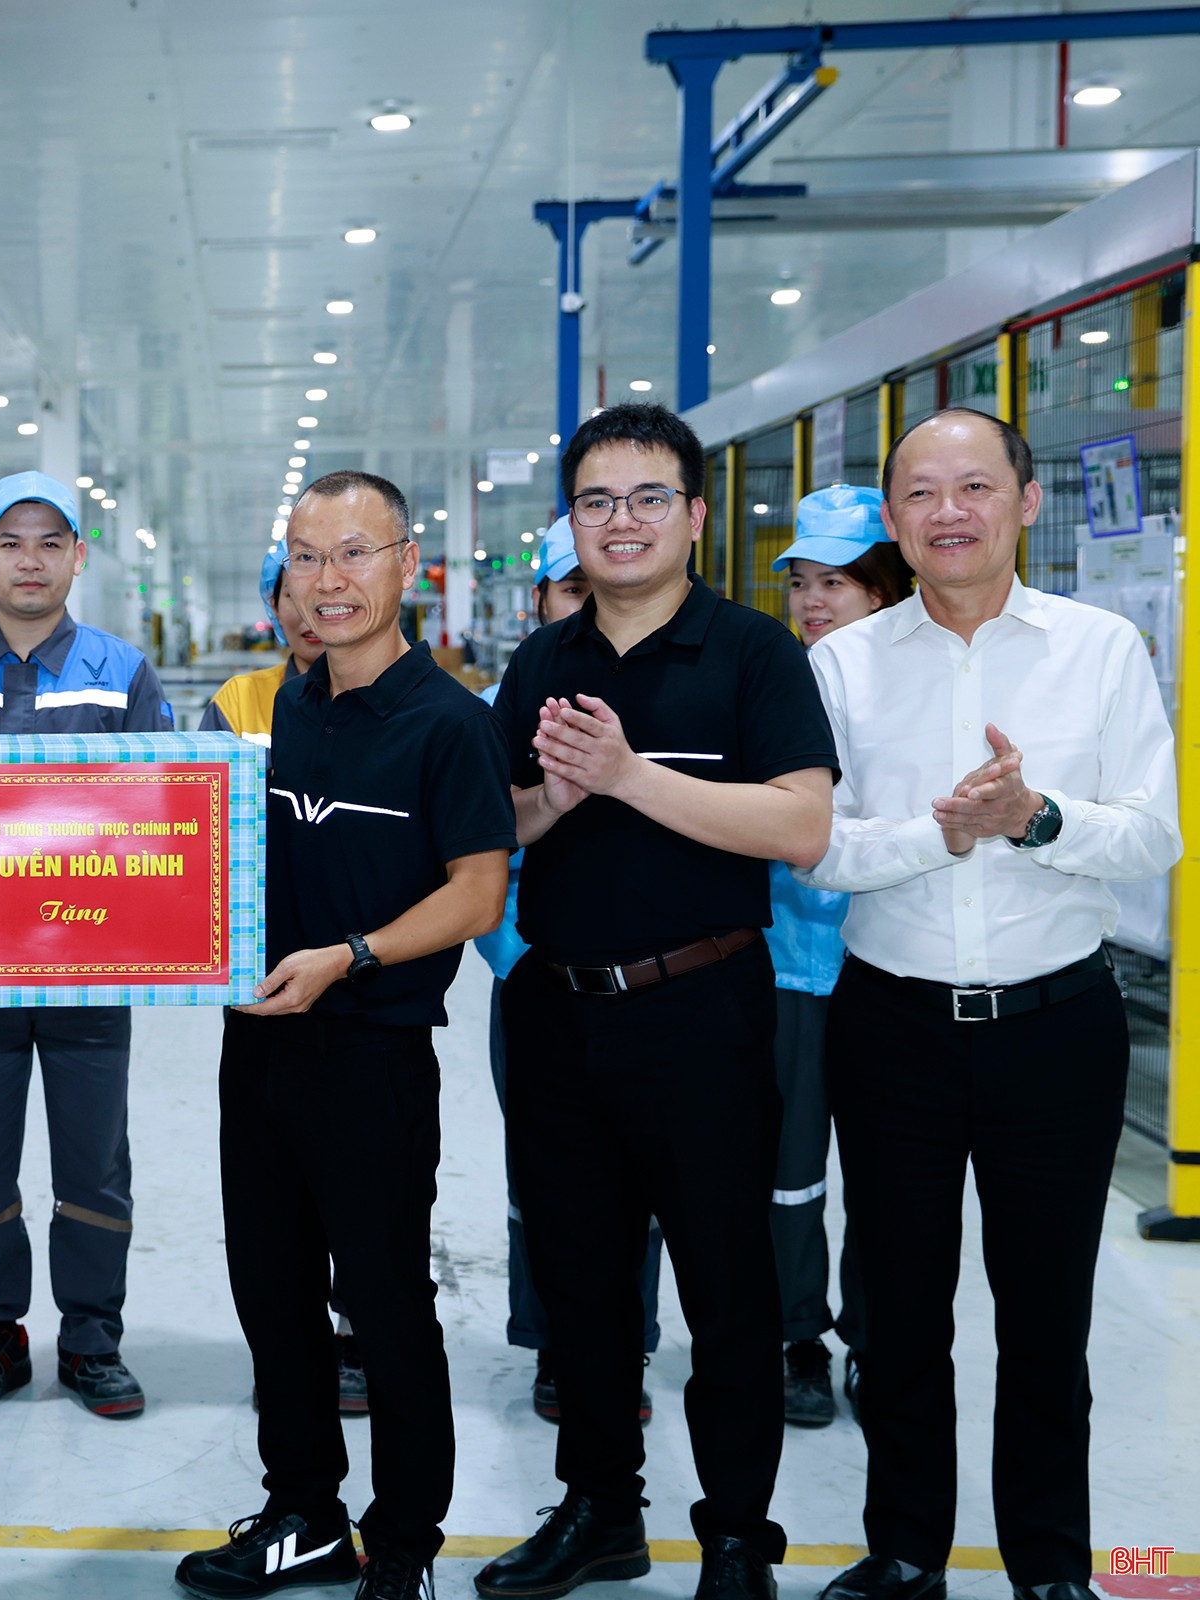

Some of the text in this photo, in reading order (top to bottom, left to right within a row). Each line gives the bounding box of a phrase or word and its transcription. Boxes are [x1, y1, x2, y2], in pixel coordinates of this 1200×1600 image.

[3, 820, 43, 837] TƯỚNG
[47, 820, 95, 837] THƯỜNG
[98, 820, 129, 839] TRỰC
[133, 820, 171, 836] CHÍNH
[173, 818, 199, 836] PHỦ
[69, 849, 119, 877] HÒA
[125, 849, 184, 877] BÌNH
[39, 900, 109, 926] Tặng
